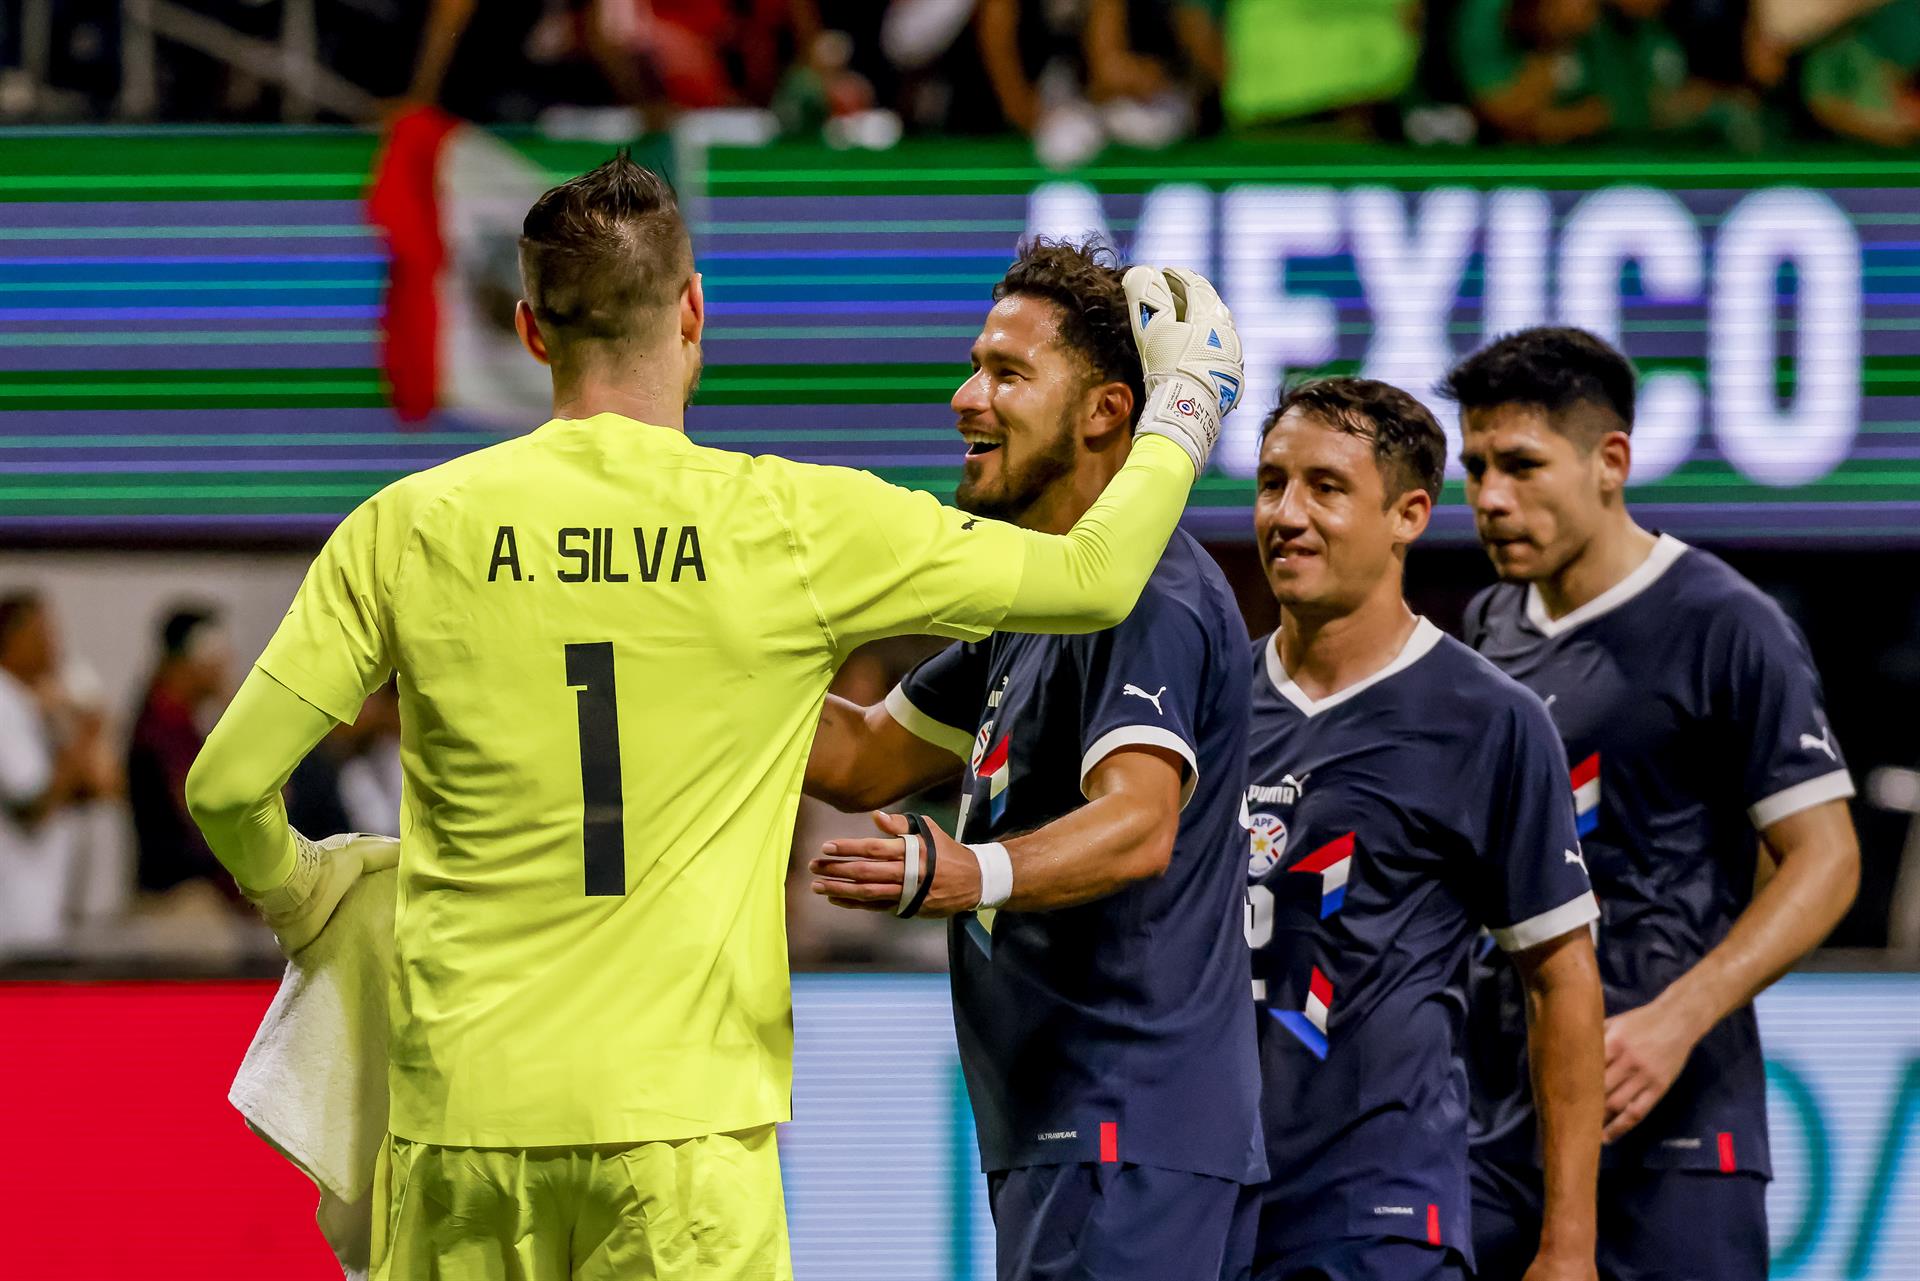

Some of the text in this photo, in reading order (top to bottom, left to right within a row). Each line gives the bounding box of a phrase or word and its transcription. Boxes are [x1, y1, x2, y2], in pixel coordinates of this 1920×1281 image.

[1022, 181, 1864, 486] EXICO
[487, 525, 707, 583] A. SILVA
[564, 641, 626, 897] 1
[1247, 784, 1295, 805] PUMA
[1253, 817, 1274, 828] APF
